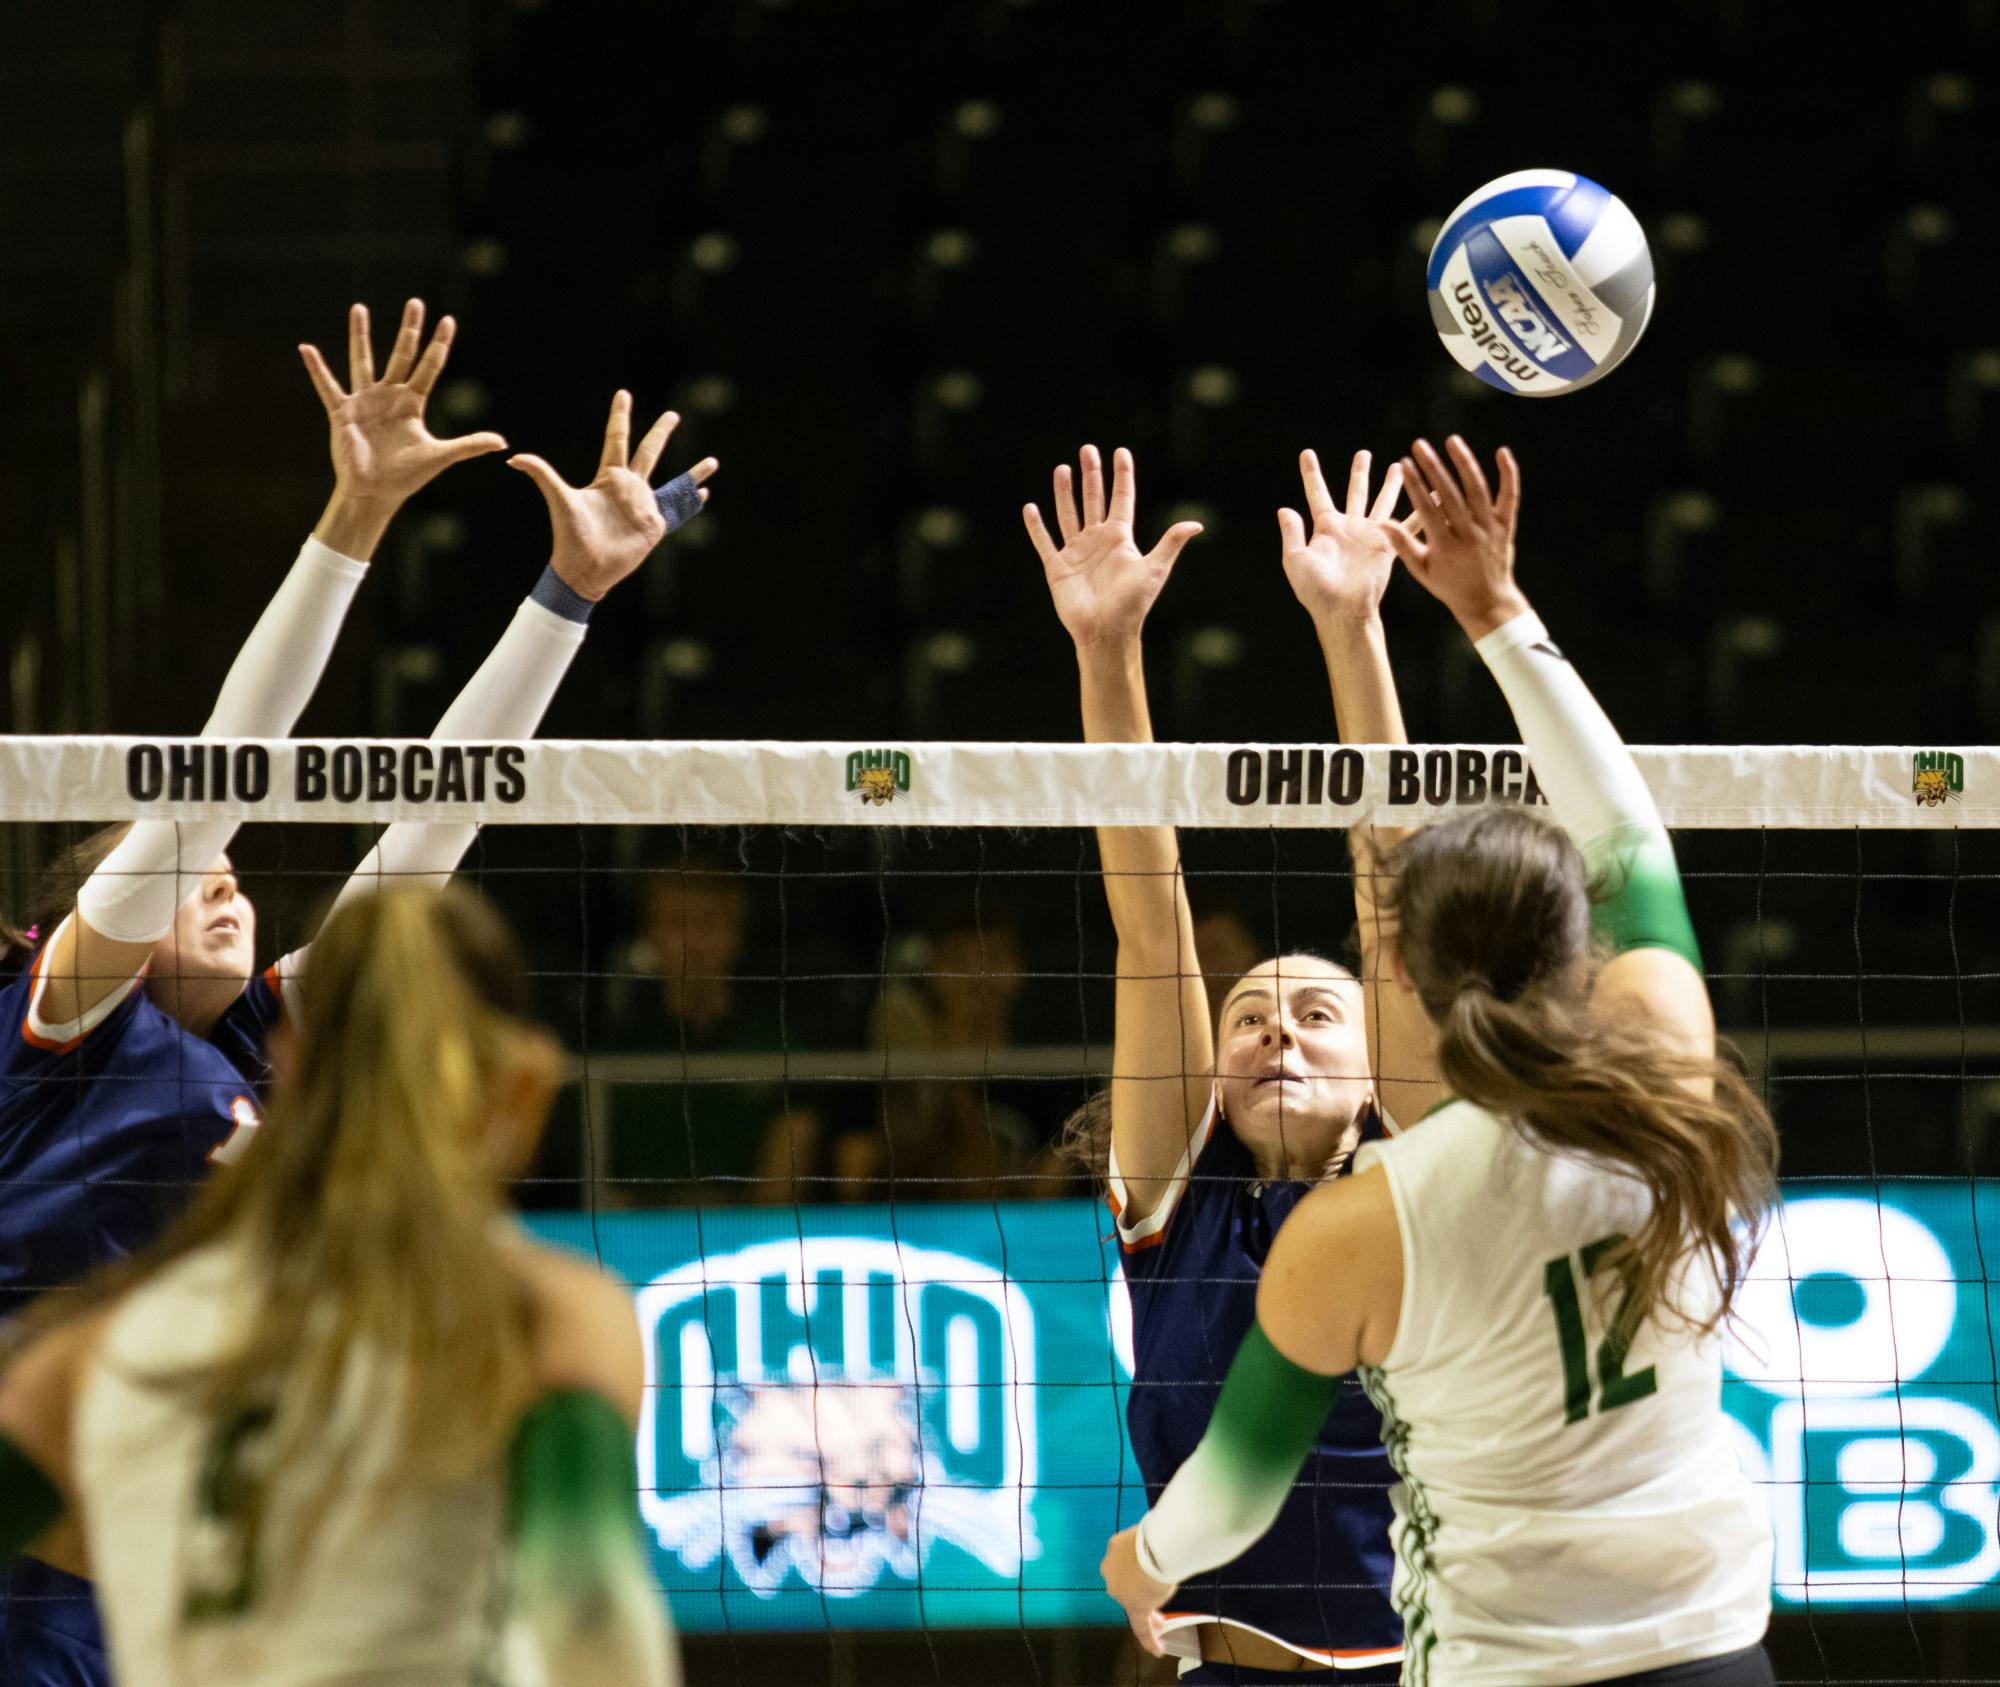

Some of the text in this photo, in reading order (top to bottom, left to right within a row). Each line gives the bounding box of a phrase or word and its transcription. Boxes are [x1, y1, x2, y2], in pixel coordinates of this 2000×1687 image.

[1454, 281, 1539, 381] molten
[1483, 272, 1571, 363] NCAA
[126, 744, 526, 803] OHIO BOBCATS
[1226, 748, 1549, 806] OHIO BOBCA
[1544, 1233, 1657, 1424] 12
